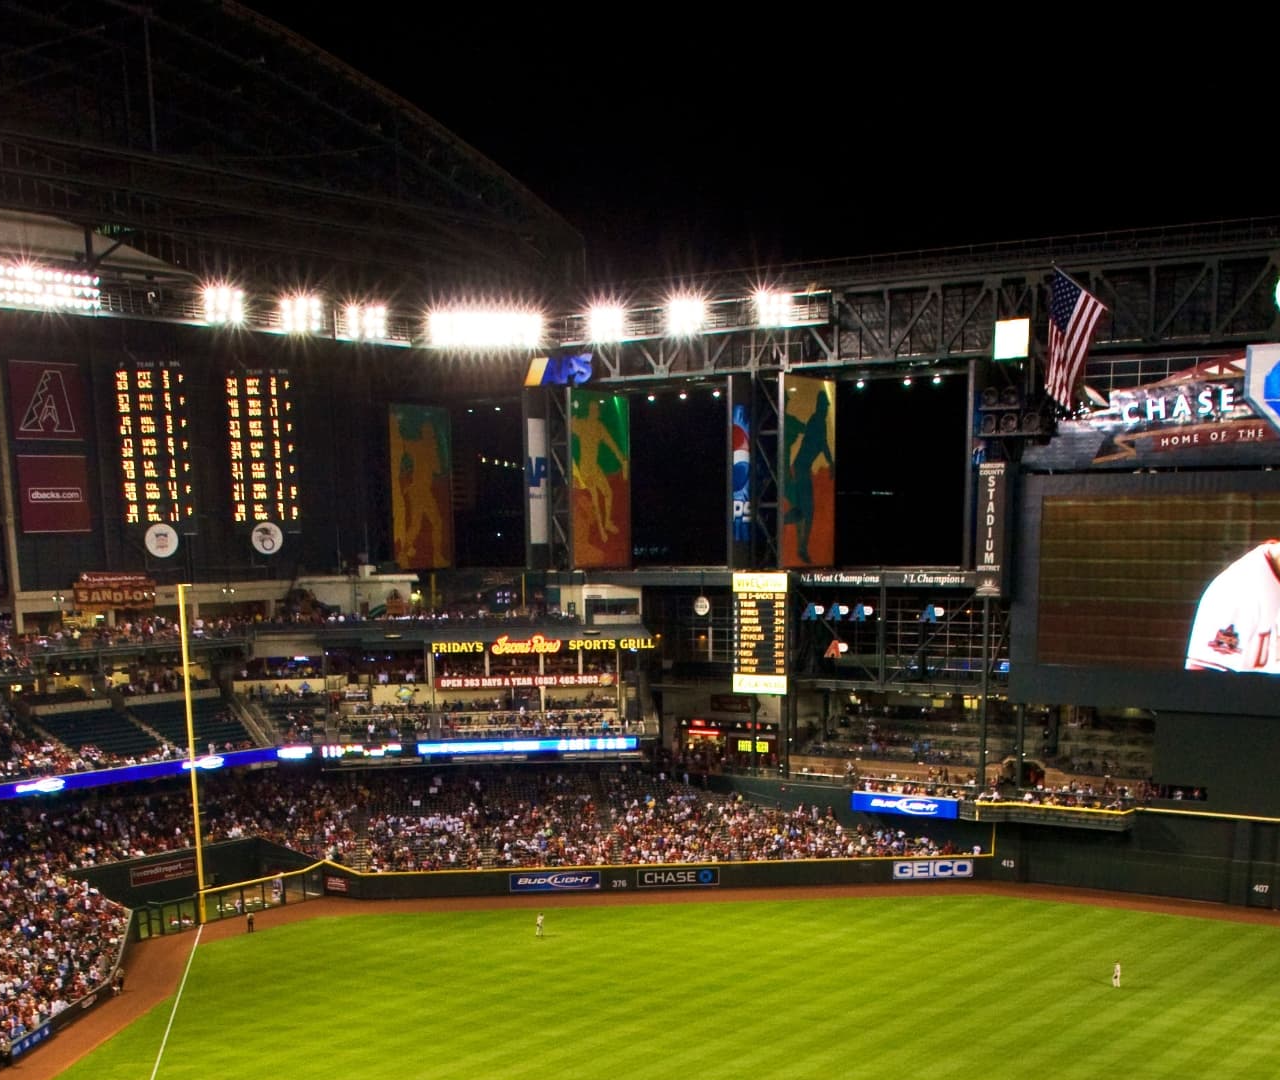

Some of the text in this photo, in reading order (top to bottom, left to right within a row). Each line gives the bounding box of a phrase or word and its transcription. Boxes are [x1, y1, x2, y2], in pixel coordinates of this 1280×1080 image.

[1121, 386, 1236, 424] CHASE
[1160, 432, 1201, 447] HOME
[1209, 430, 1229, 442] OF
[1237, 427, 1266, 439] THE
[30, 490, 80, 499] dbacks.com
[983, 475, 996, 565] STADIUM
[800, 573, 880, 585] NL West Champions
[917, 573, 966, 586] Champions
[79, 589, 150, 603] SANDLO
[431, 641, 484, 654] FRIDAY'S
[568, 638, 616, 651] SPORTS
[620, 637, 655, 650] GRILL
[440, 678, 464, 688] OPEN
[463, 677, 481, 687] 363
[481, 677, 502, 687] DAYS
[503, 677, 511, 686] A
[511, 676, 534, 686] YEAR
[901, 801, 939, 812] LIGHT
[894, 861, 971, 877] GEICO
[1001, 859, 1015, 868] 413
[517, 874, 593, 886] BUD LIGHT
[643, 871, 696, 884] CHASE
